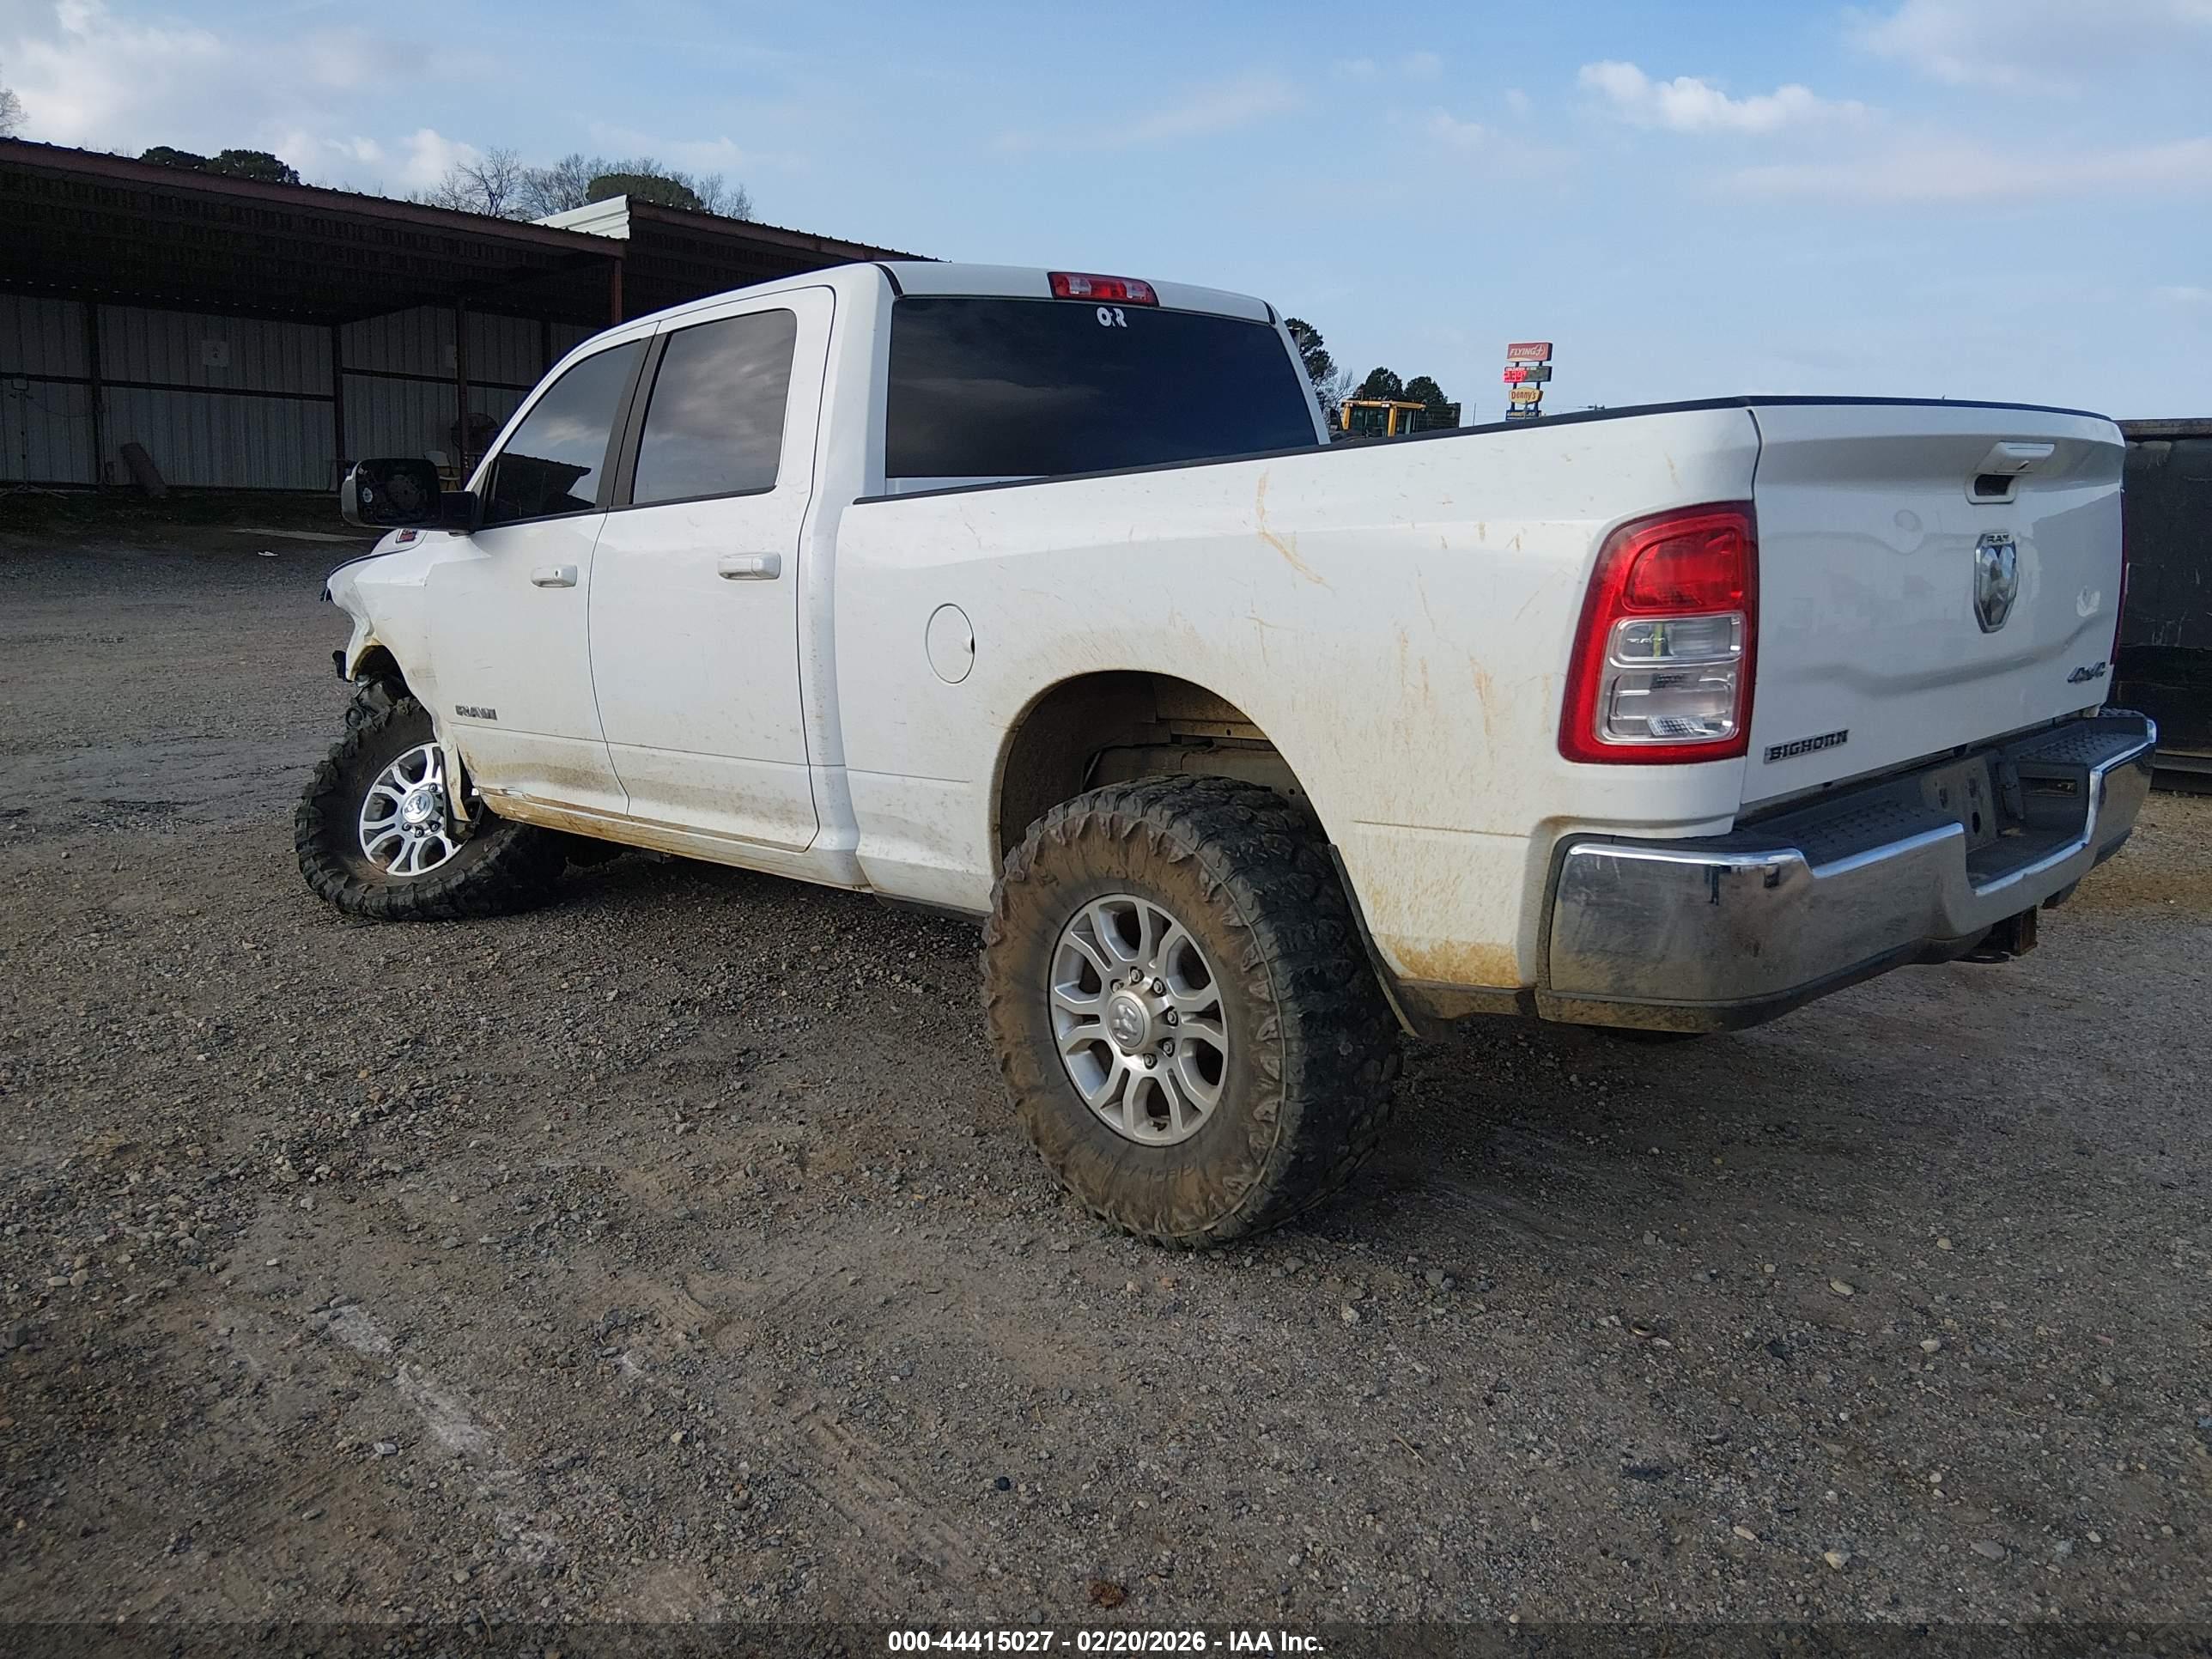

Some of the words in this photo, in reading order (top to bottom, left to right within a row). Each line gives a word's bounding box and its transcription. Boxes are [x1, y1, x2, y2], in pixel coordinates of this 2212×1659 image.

[1510, 347, 1535, 356] FLYING
[1510, 389, 1537, 401] Denny's
[455, 704, 498, 721] RAM
[1769, 728, 1850, 761] BIGHORN
